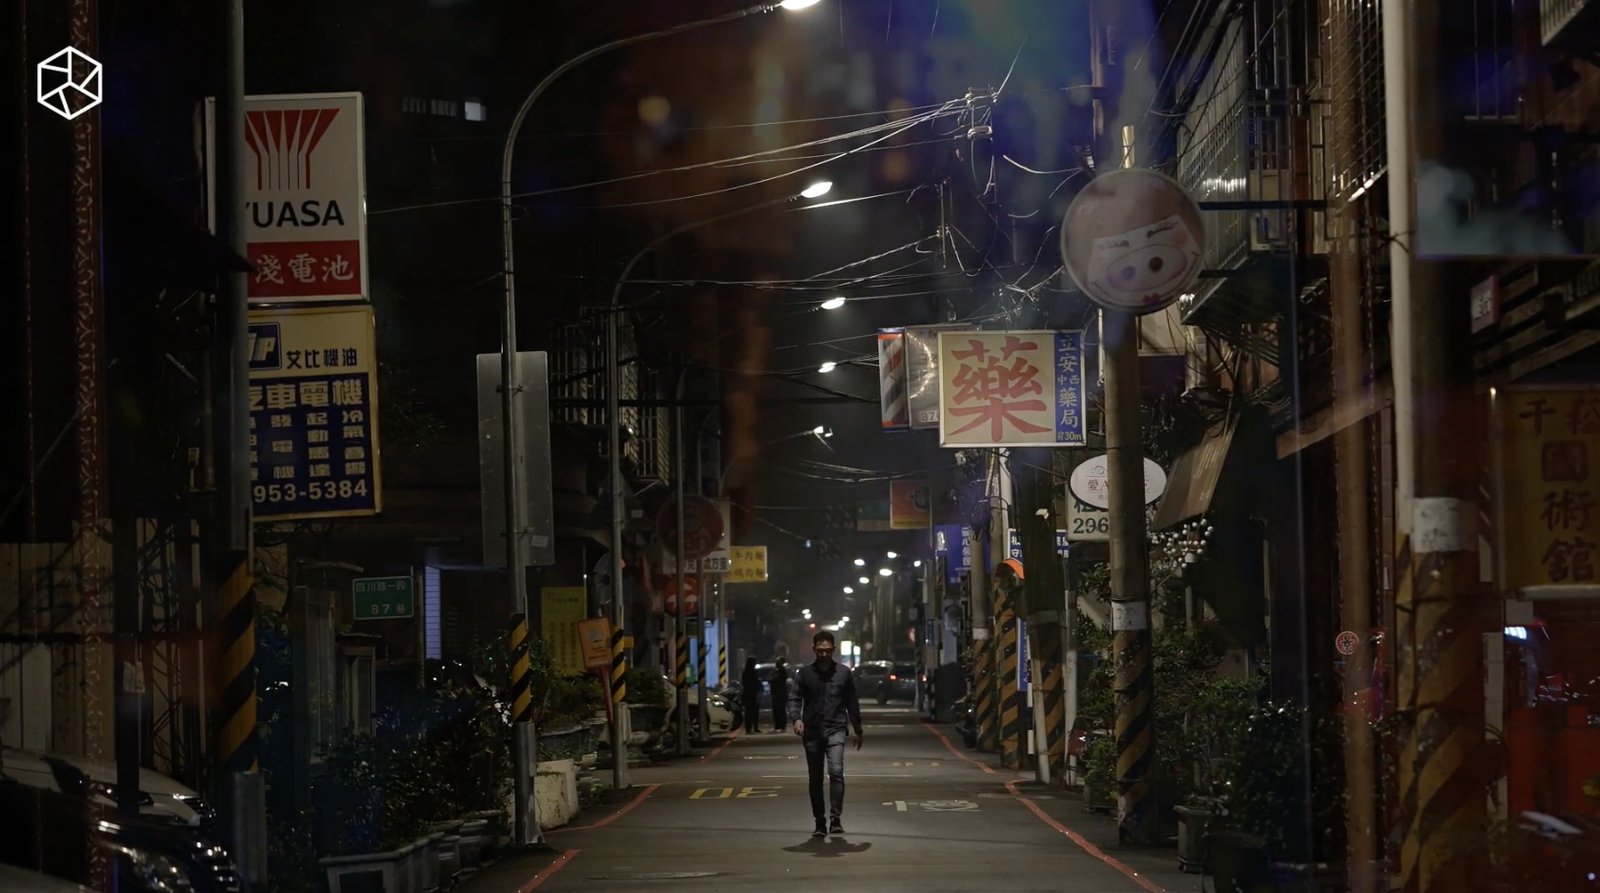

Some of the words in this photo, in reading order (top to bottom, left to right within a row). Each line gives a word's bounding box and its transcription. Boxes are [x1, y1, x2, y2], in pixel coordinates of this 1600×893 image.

[246, 200, 345, 228] UASA
[255, 253, 355, 286] 淺電池
[286, 346, 358, 370] 艾比機油
[947, 336, 1053, 442] 藥
[253, 478, 368, 503] 953-5384
